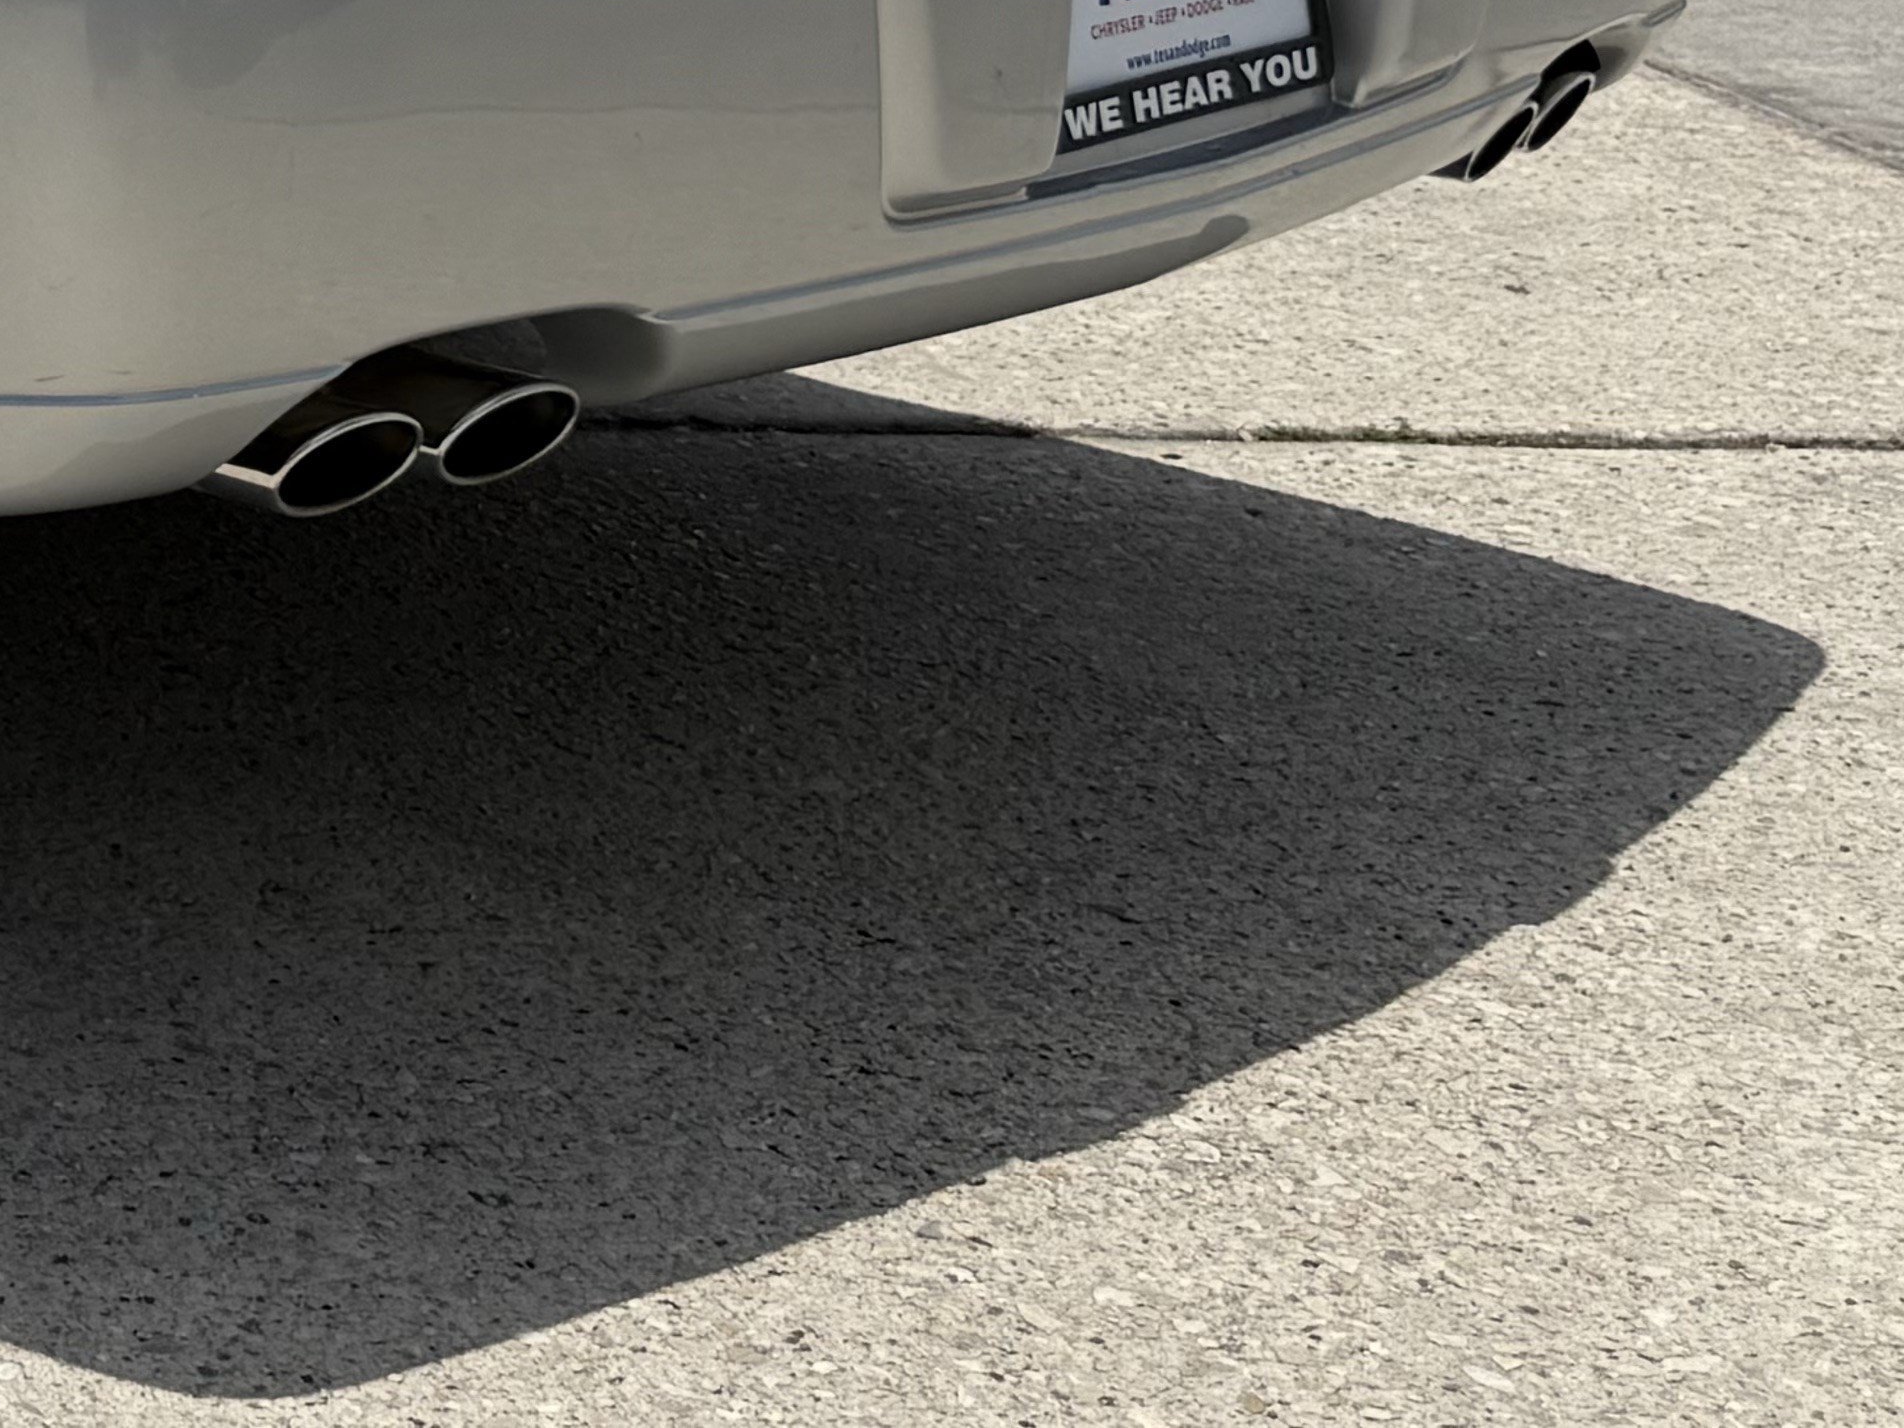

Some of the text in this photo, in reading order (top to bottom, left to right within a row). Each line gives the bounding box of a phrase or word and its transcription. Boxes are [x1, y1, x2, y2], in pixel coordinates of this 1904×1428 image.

[1090, 14, 1146, 40] CHRYSLER
[1154, 6, 1178, 25] JEEP
[1064, 46, 1319, 140] WE HEAR YOU
